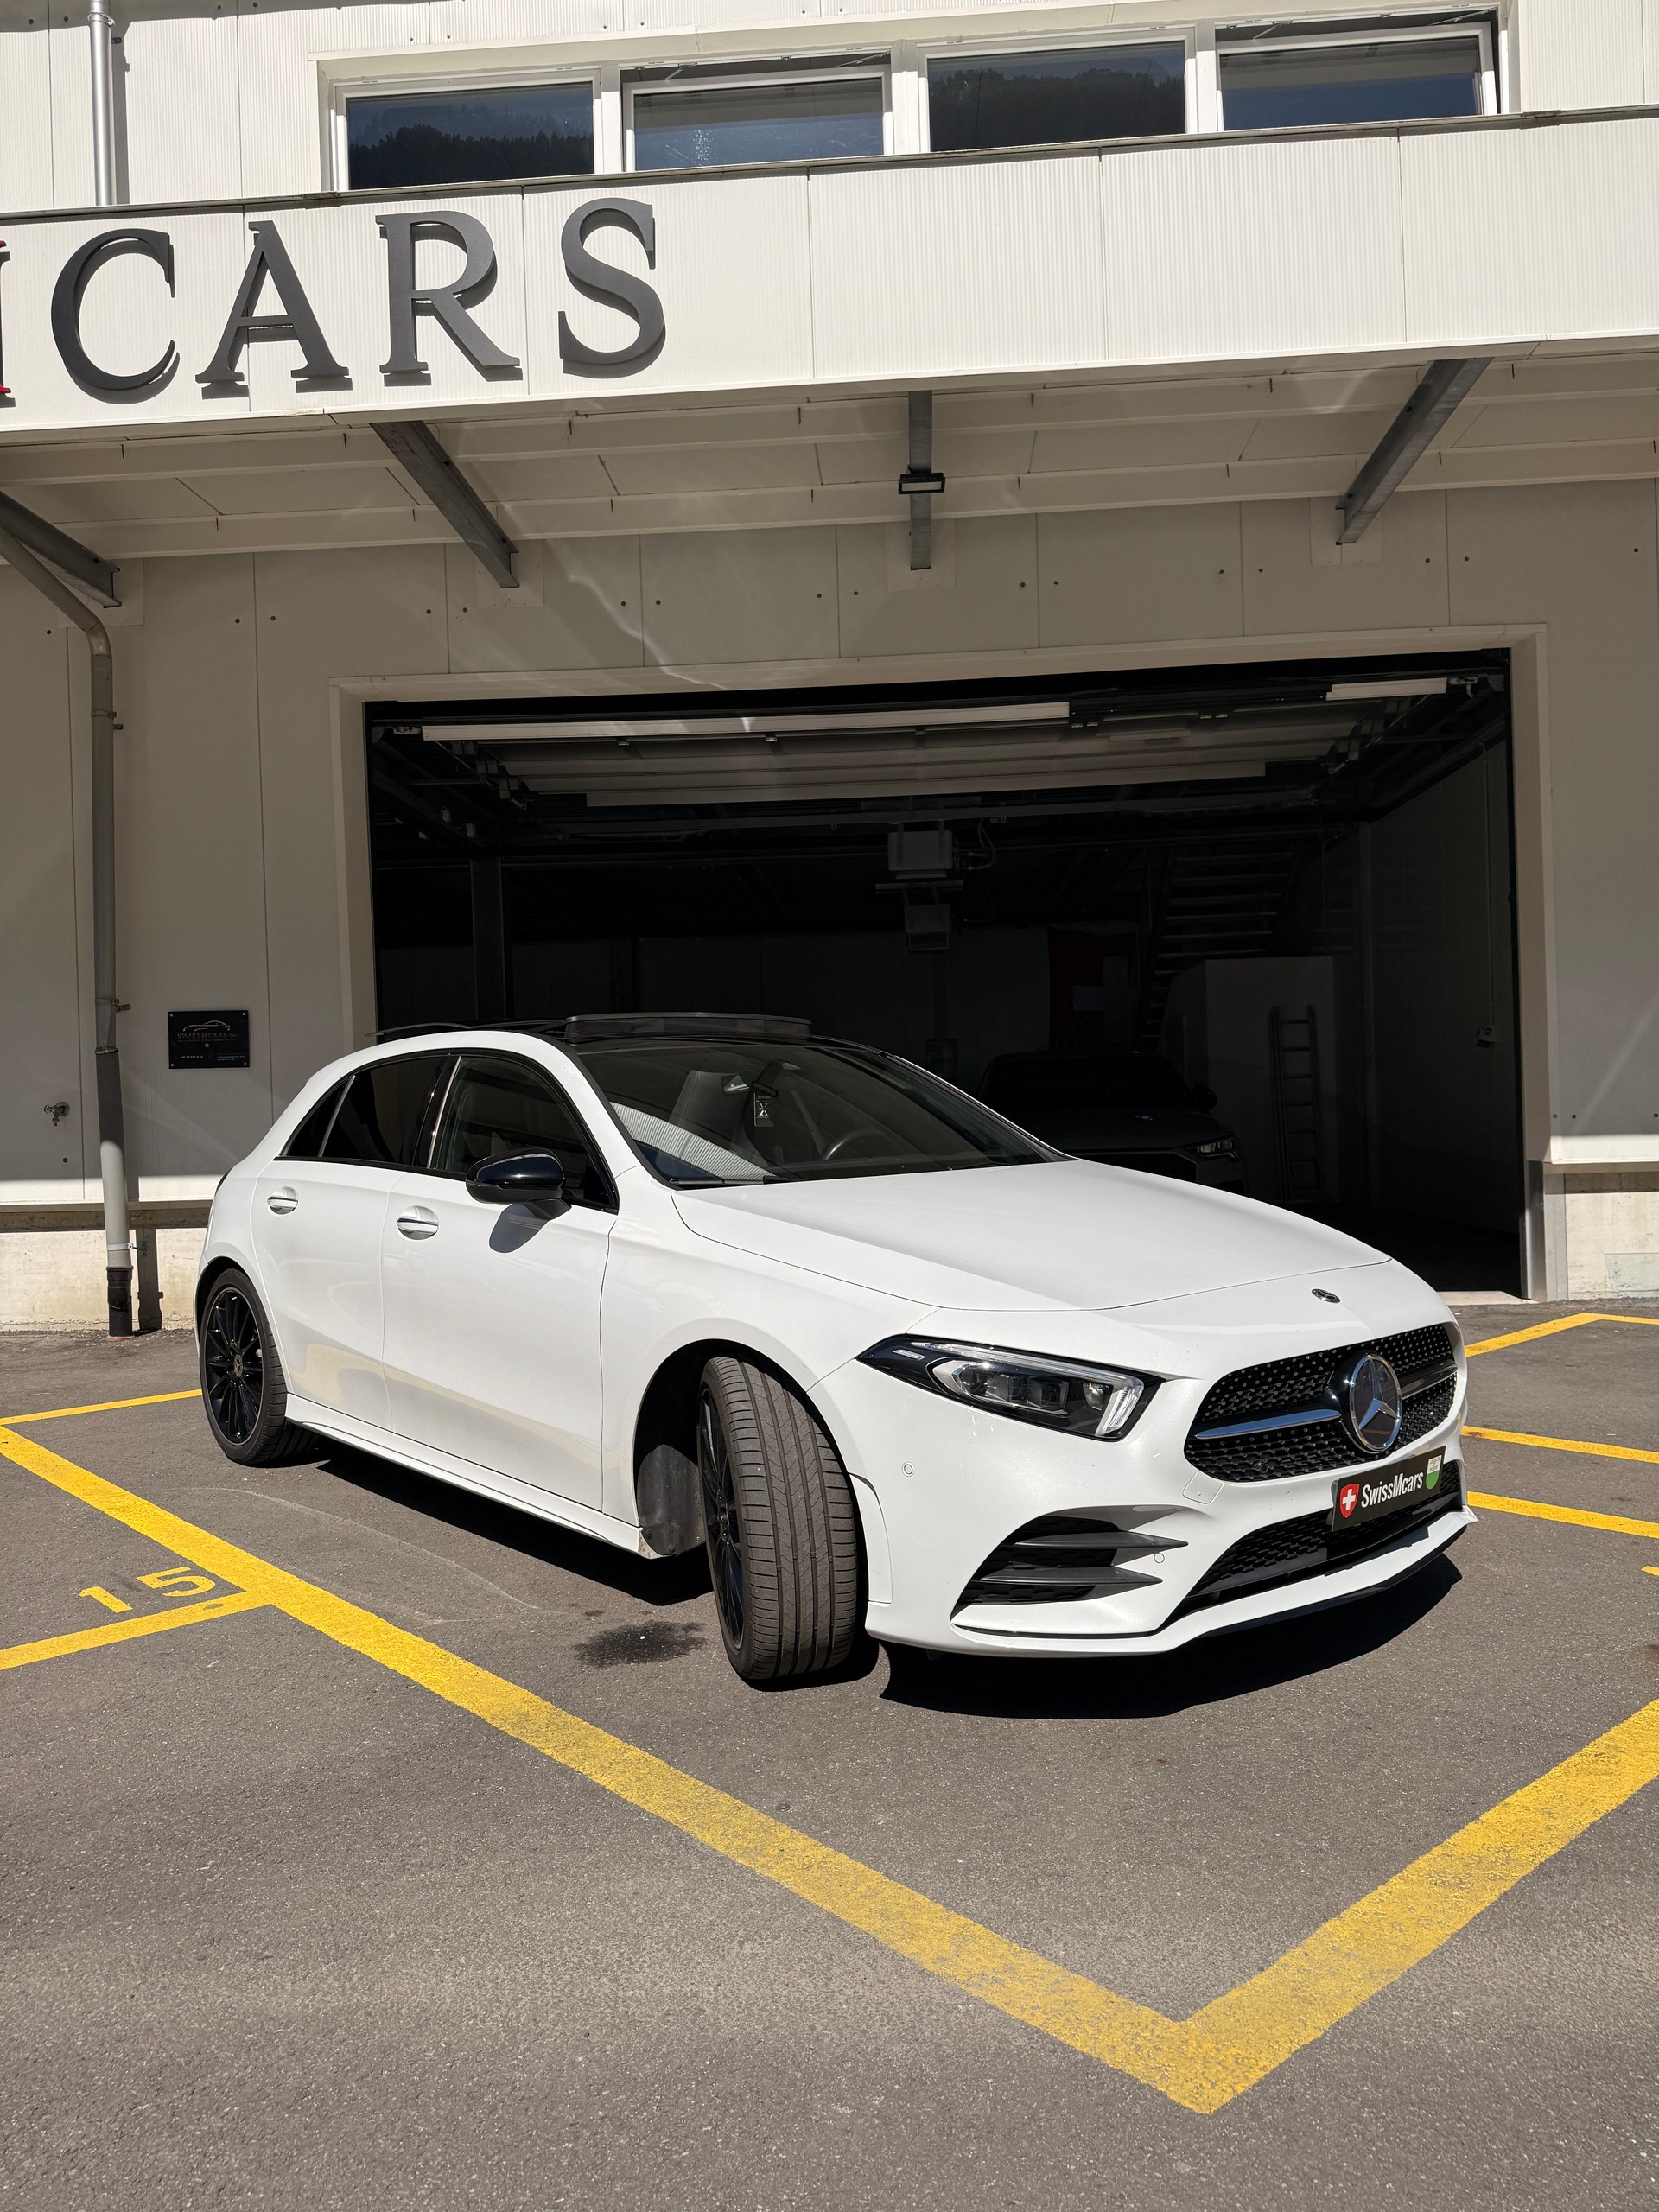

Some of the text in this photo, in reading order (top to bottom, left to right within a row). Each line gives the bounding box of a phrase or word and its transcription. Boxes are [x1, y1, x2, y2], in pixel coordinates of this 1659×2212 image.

[0, 197, 666, 393] CARS
[1361, 1471, 1424, 1508] SwissMcars
[79, 1566, 216, 1613] 15
